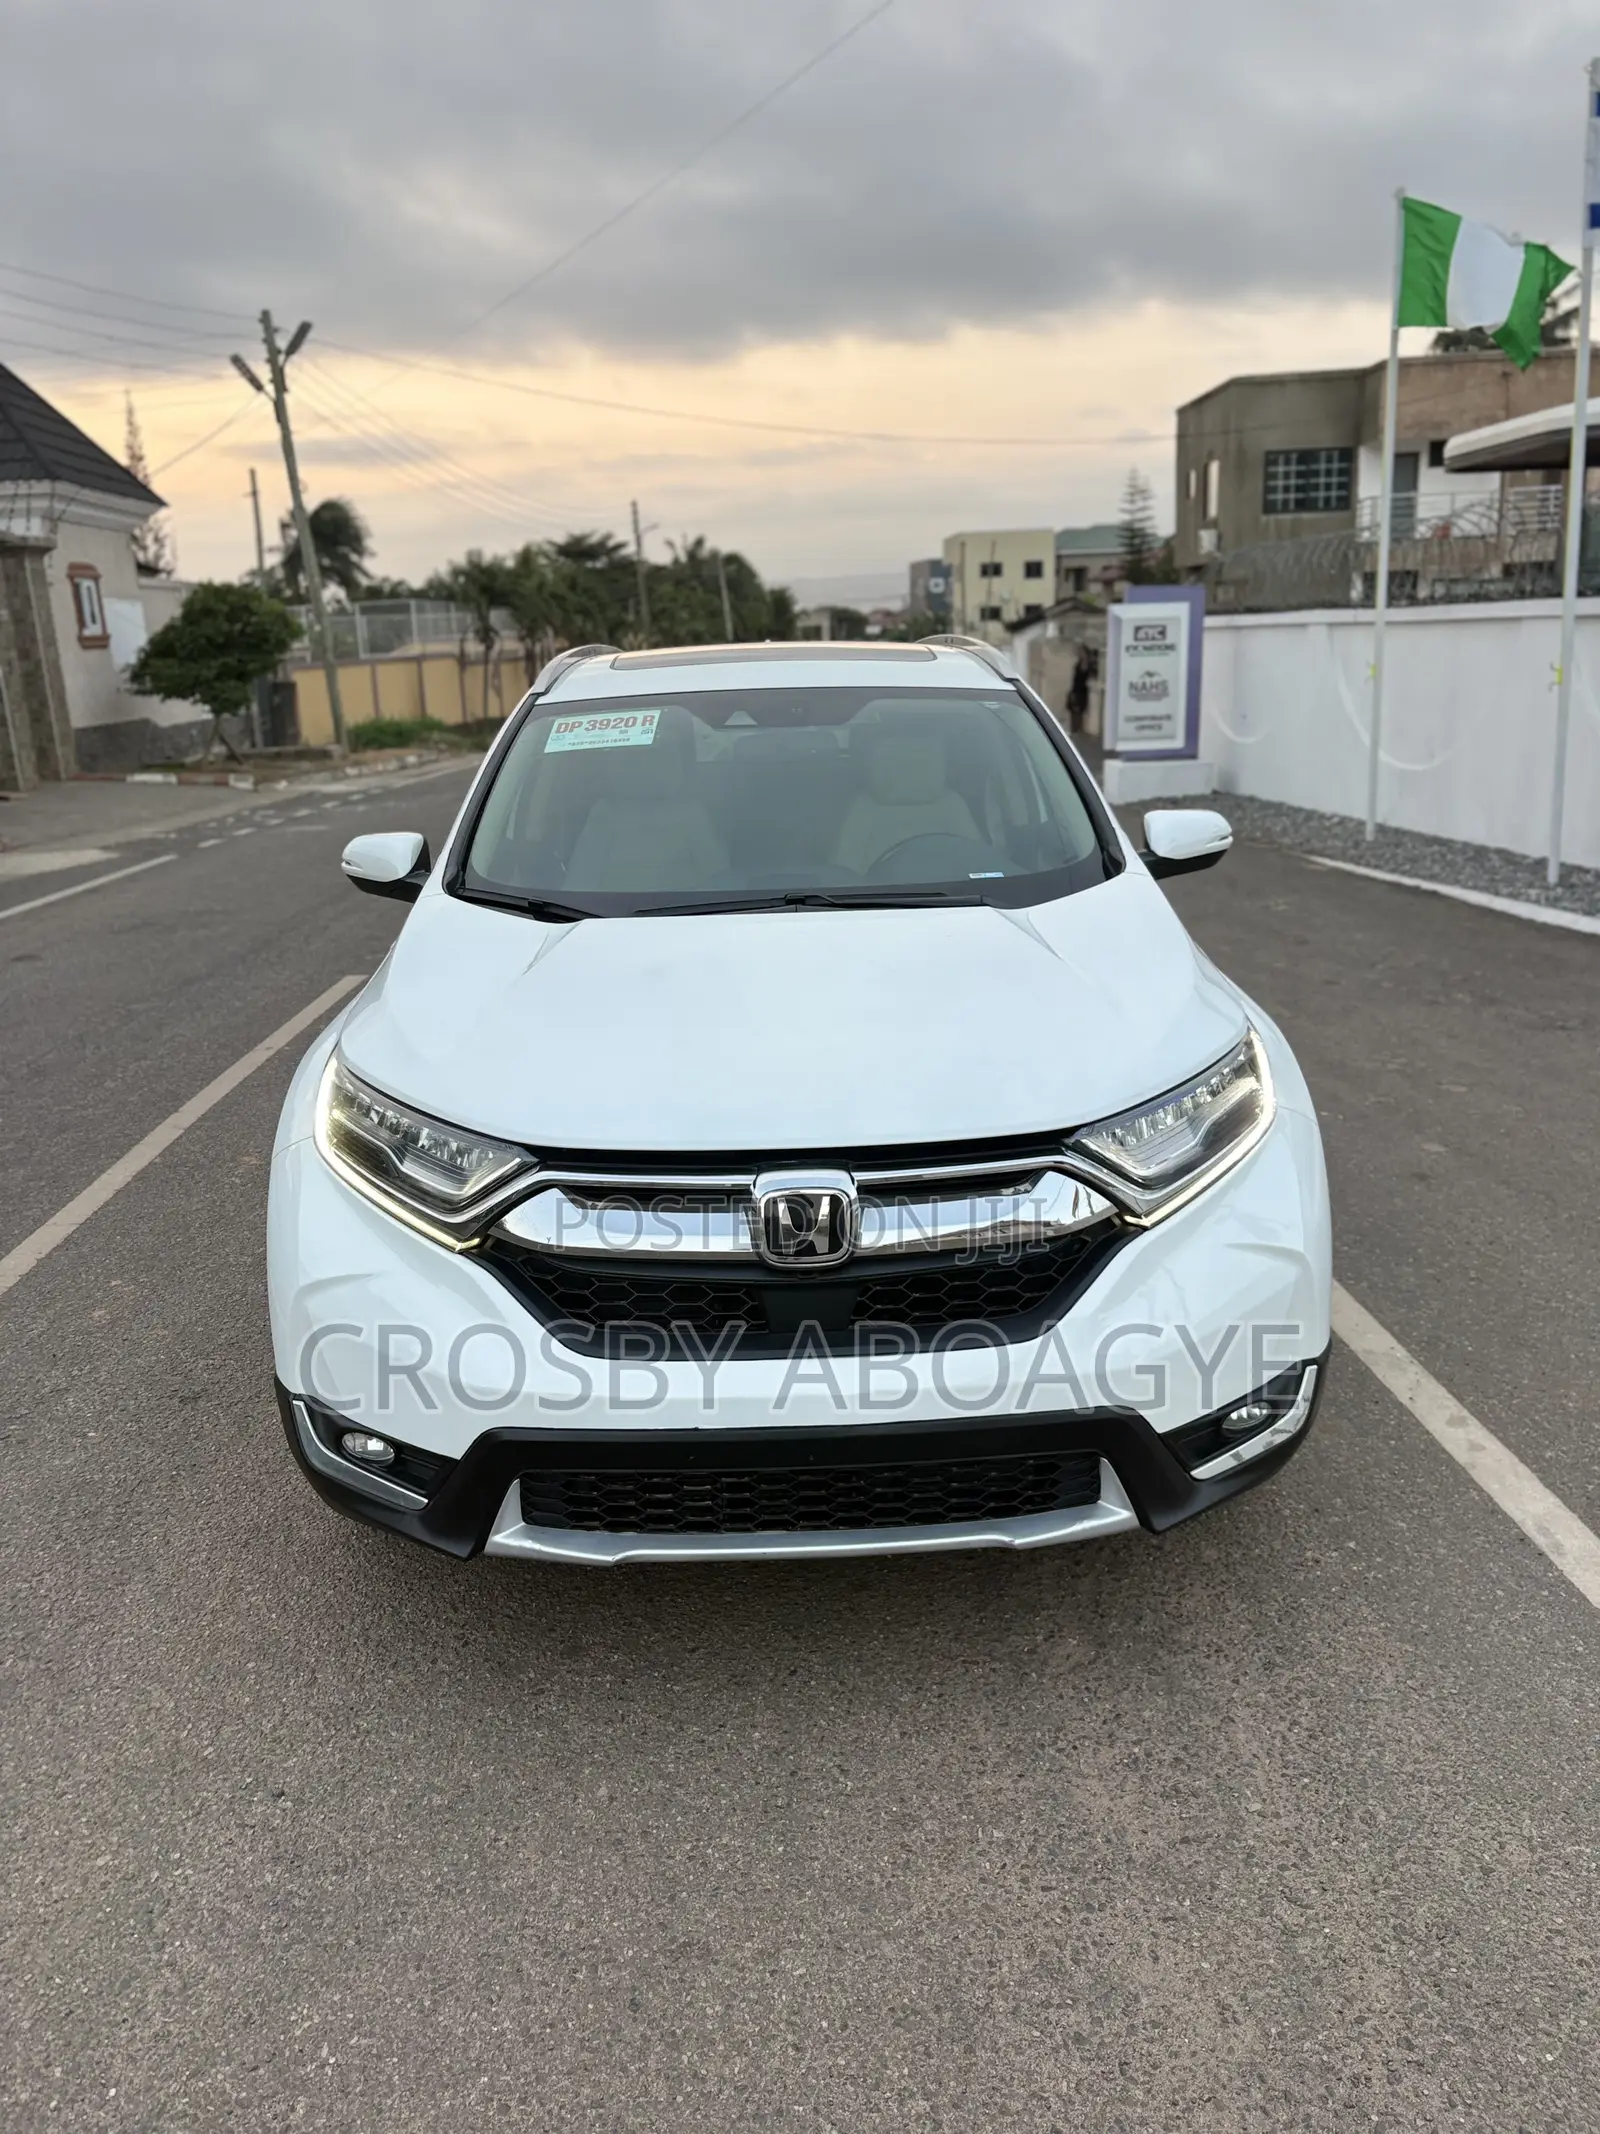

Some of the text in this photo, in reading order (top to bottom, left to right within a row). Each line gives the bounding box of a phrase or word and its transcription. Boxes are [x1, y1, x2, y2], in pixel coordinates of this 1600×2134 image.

[556, 715, 655, 733] DP 3920 R
